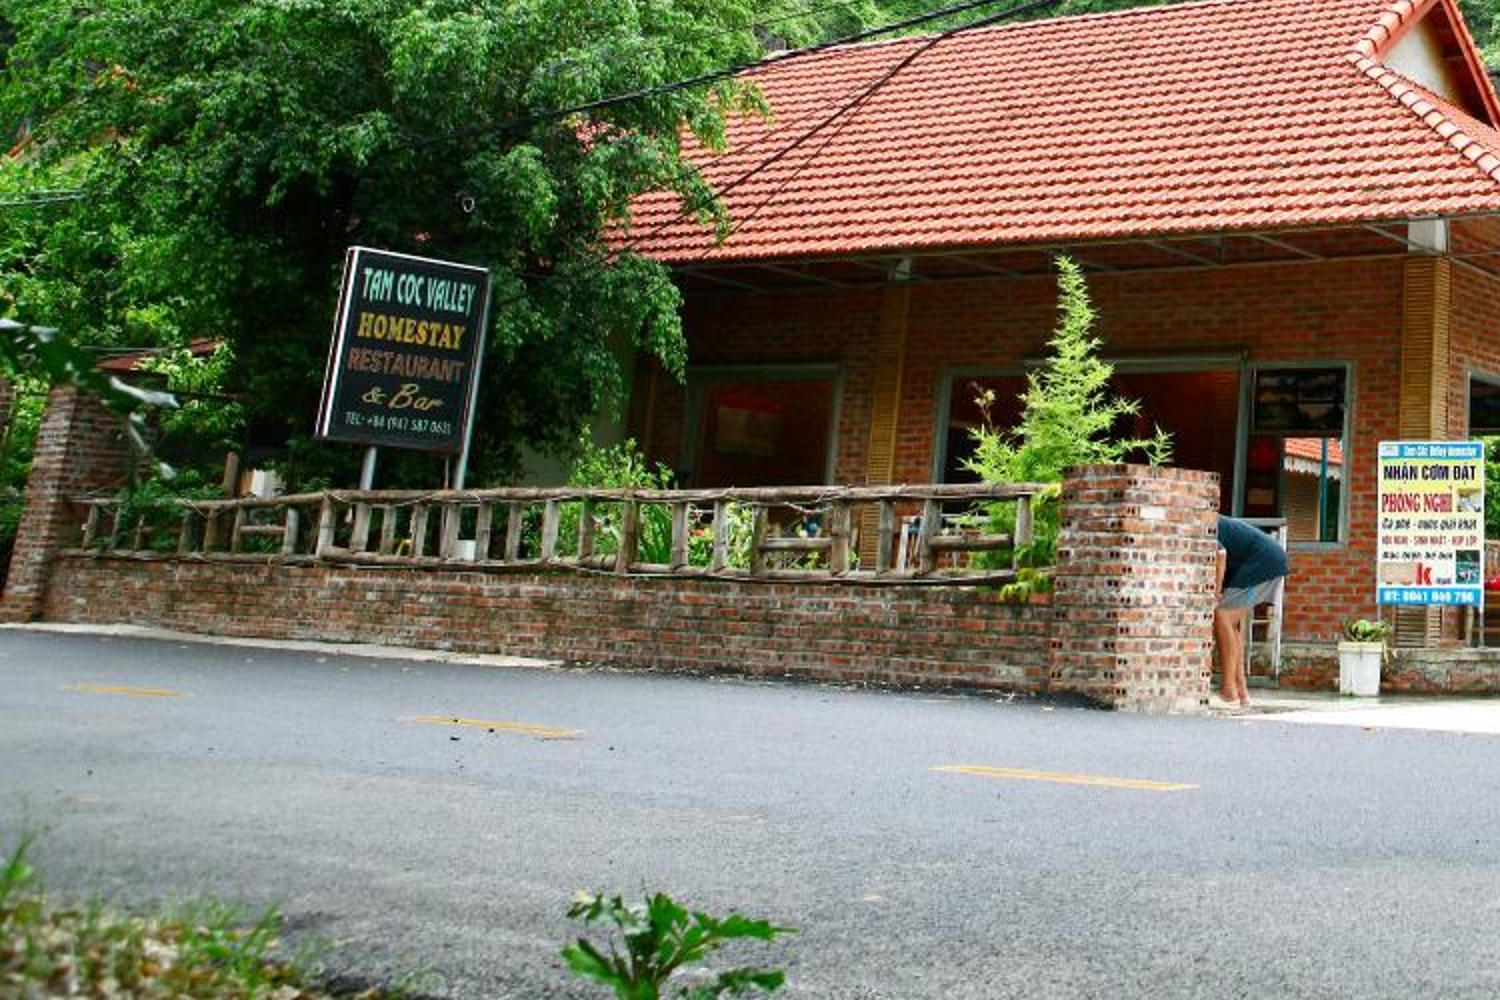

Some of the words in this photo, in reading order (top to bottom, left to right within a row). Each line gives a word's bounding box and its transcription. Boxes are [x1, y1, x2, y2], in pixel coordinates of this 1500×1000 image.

[363, 267, 395, 302] TAM
[397, 273, 425, 307] COC
[427, 277, 477, 317] VALLEY
[358, 311, 466, 350] HOMESTAY
[347, 347, 465, 382] RESTAURANT
[361, 387, 385, 404] &
[389, 383, 445, 410] Bar
[1383, 462, 1418, 484] NHẬN
